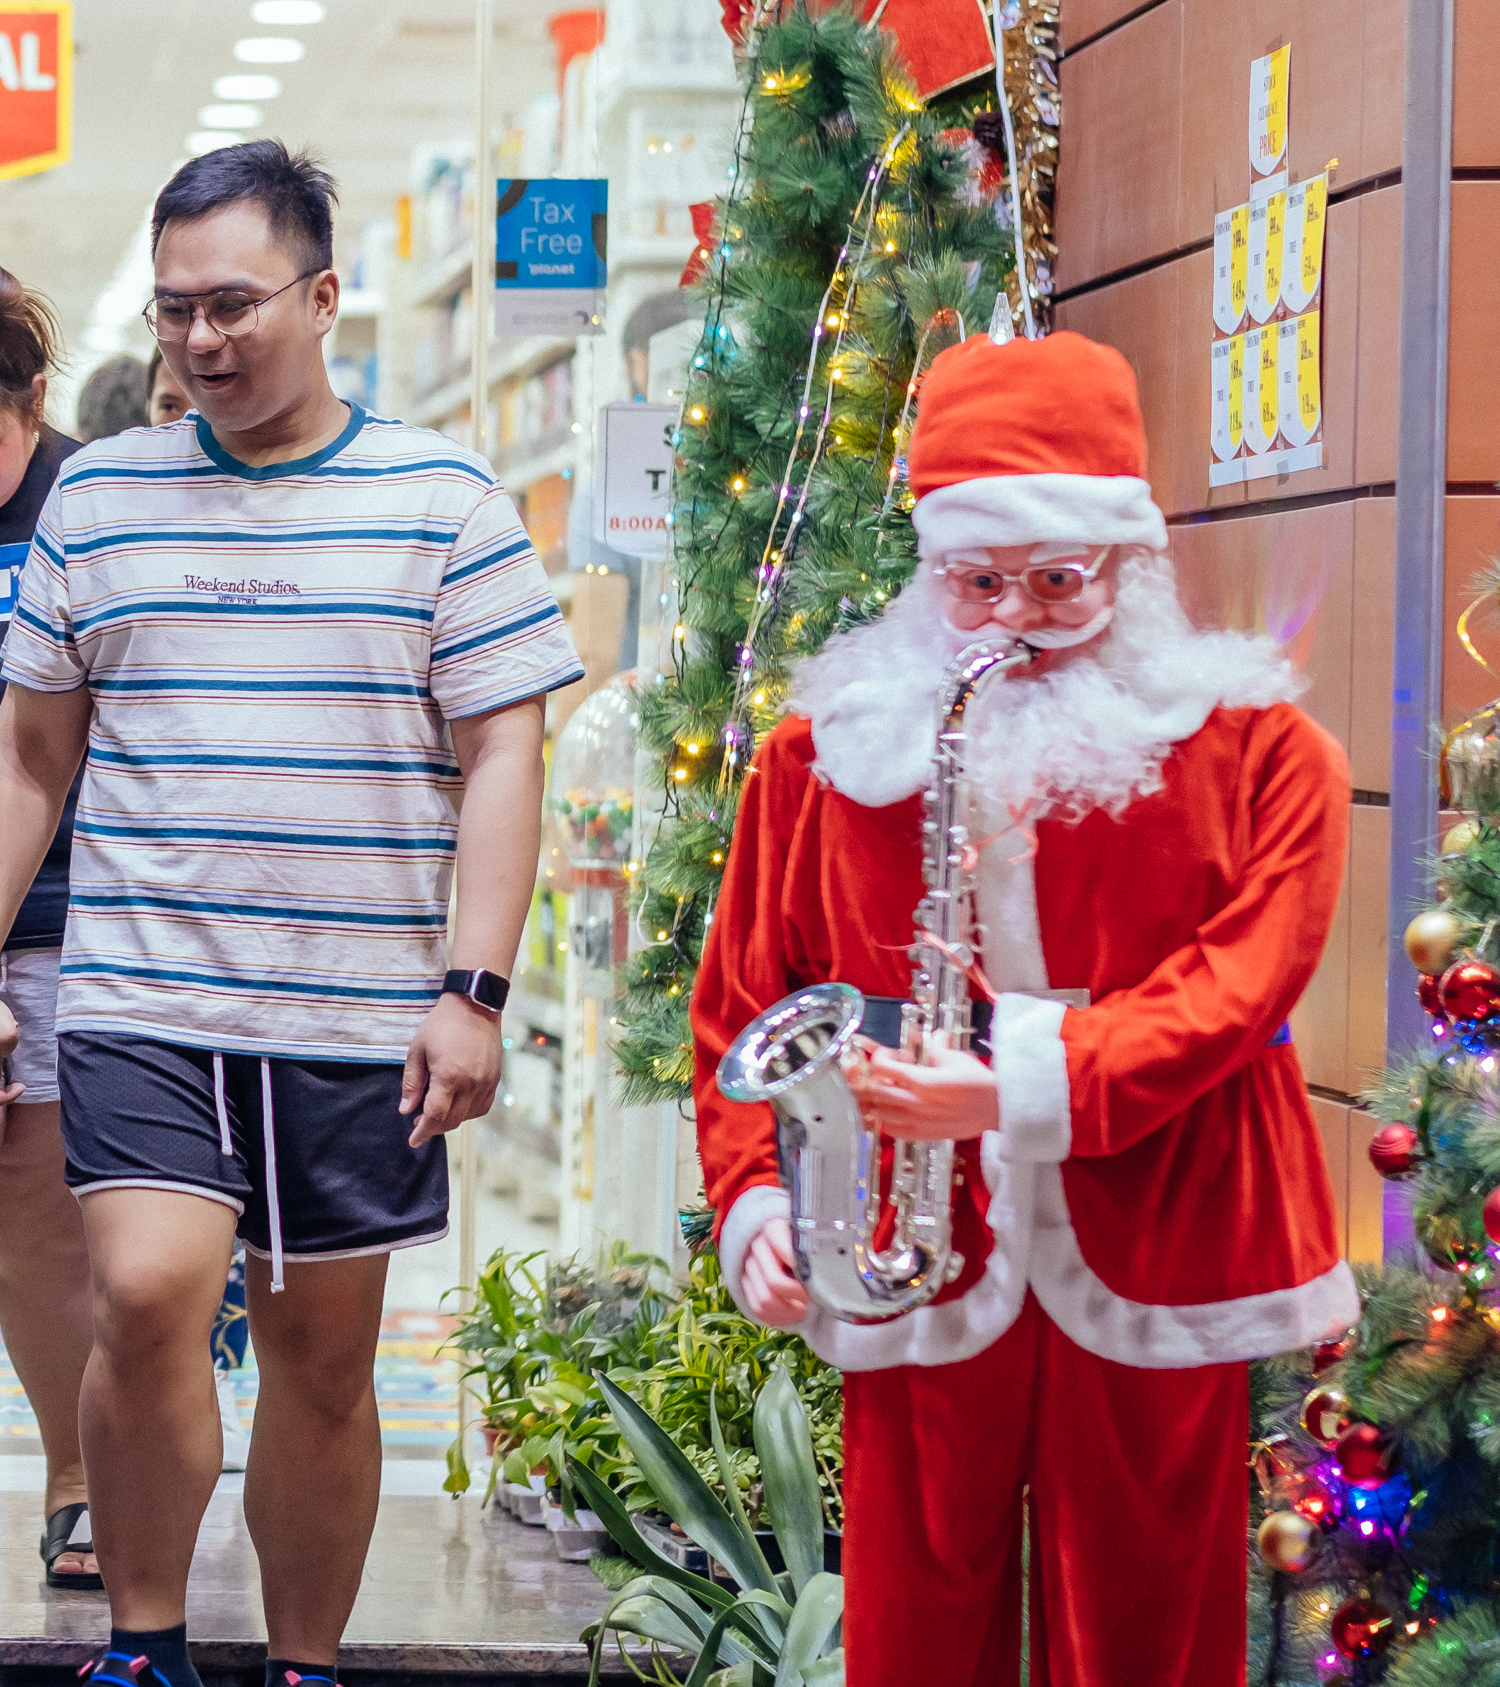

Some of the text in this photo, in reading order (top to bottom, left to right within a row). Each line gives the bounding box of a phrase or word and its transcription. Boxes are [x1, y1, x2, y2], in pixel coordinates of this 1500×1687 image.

[529, 198, 575, 225] Tax
[521, 228, 582, 255] Free
[184, 574, 246, 594] Weekend
[217, 596, 258, 606] NEW YORK
